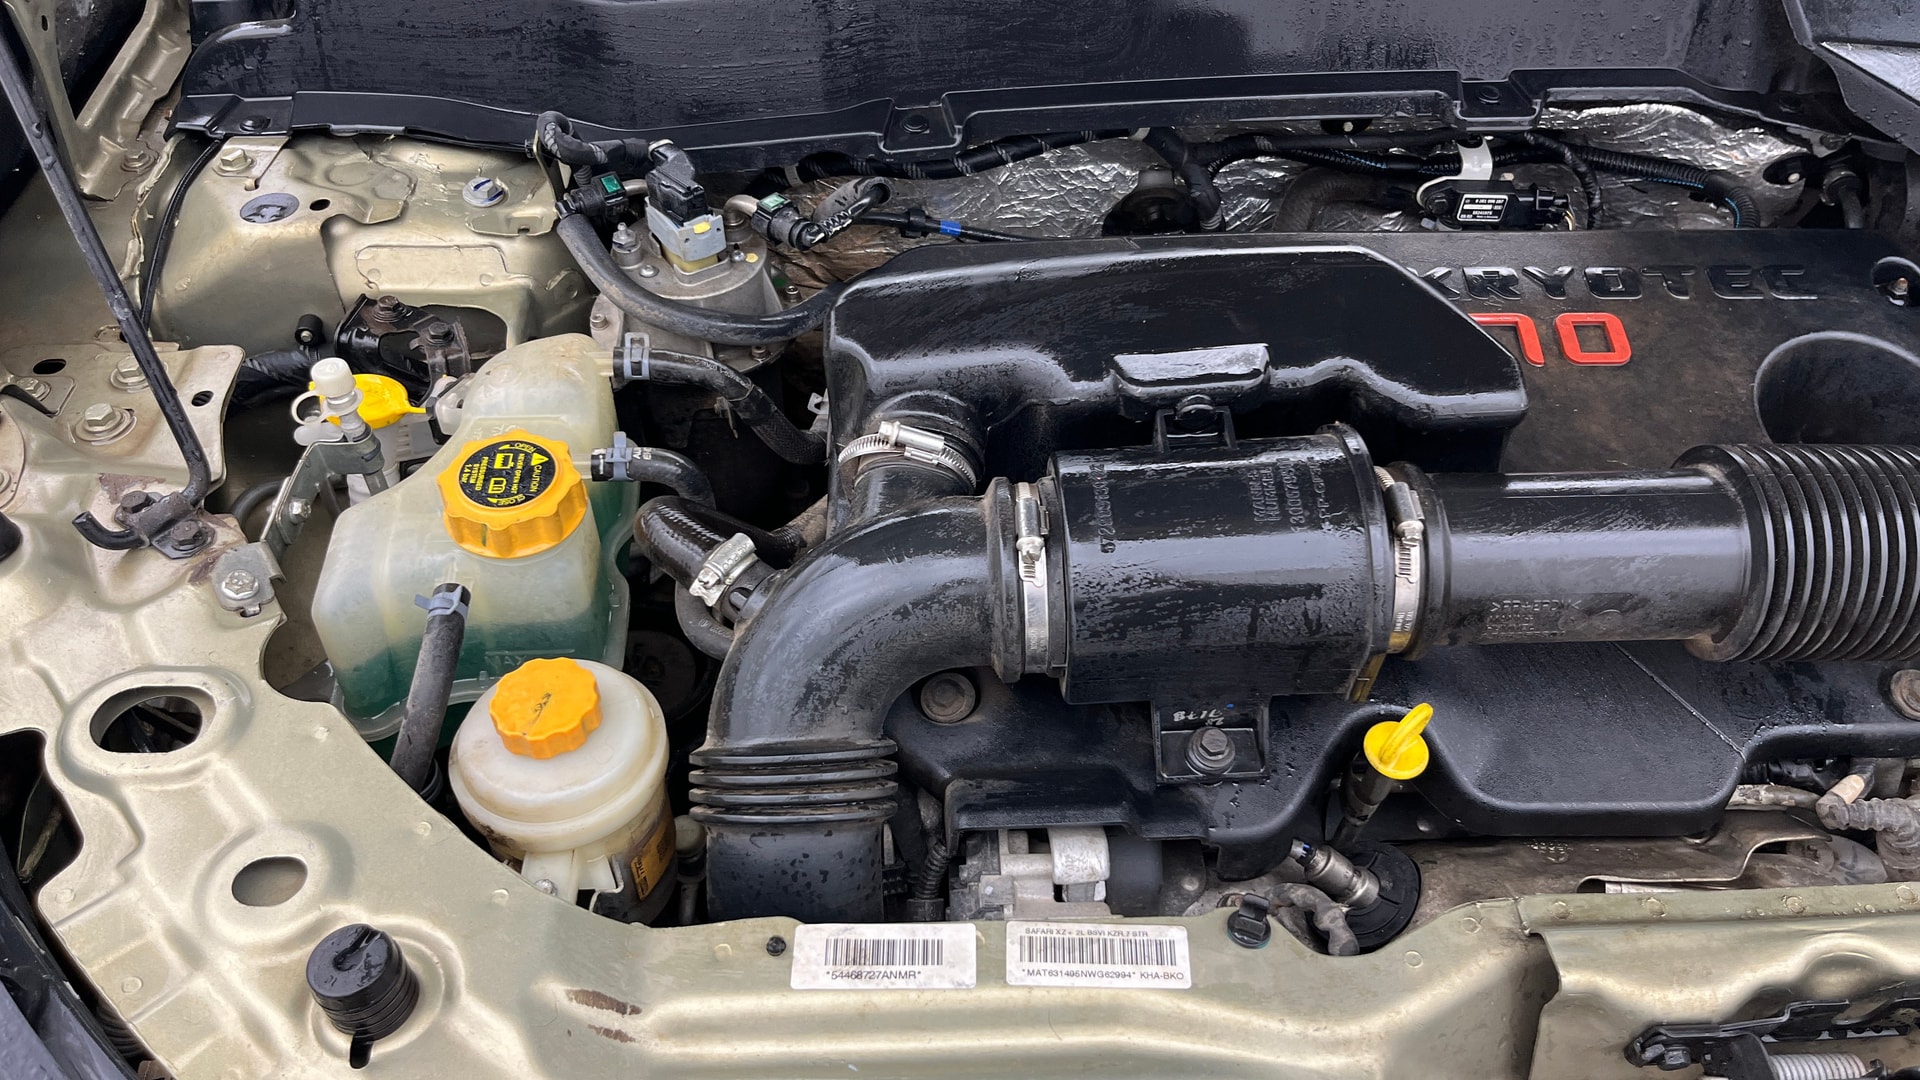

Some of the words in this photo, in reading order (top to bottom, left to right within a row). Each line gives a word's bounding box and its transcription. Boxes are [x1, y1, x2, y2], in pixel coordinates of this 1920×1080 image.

[514, 442, 536, 453] OPEN
[529, 464, 543, 492] CAUTION
[497, 493, 526, 506] CLOSE
[1132, 930, 1148, 938] STR
[1140, 972, 1184, 980] KHA-BKO
